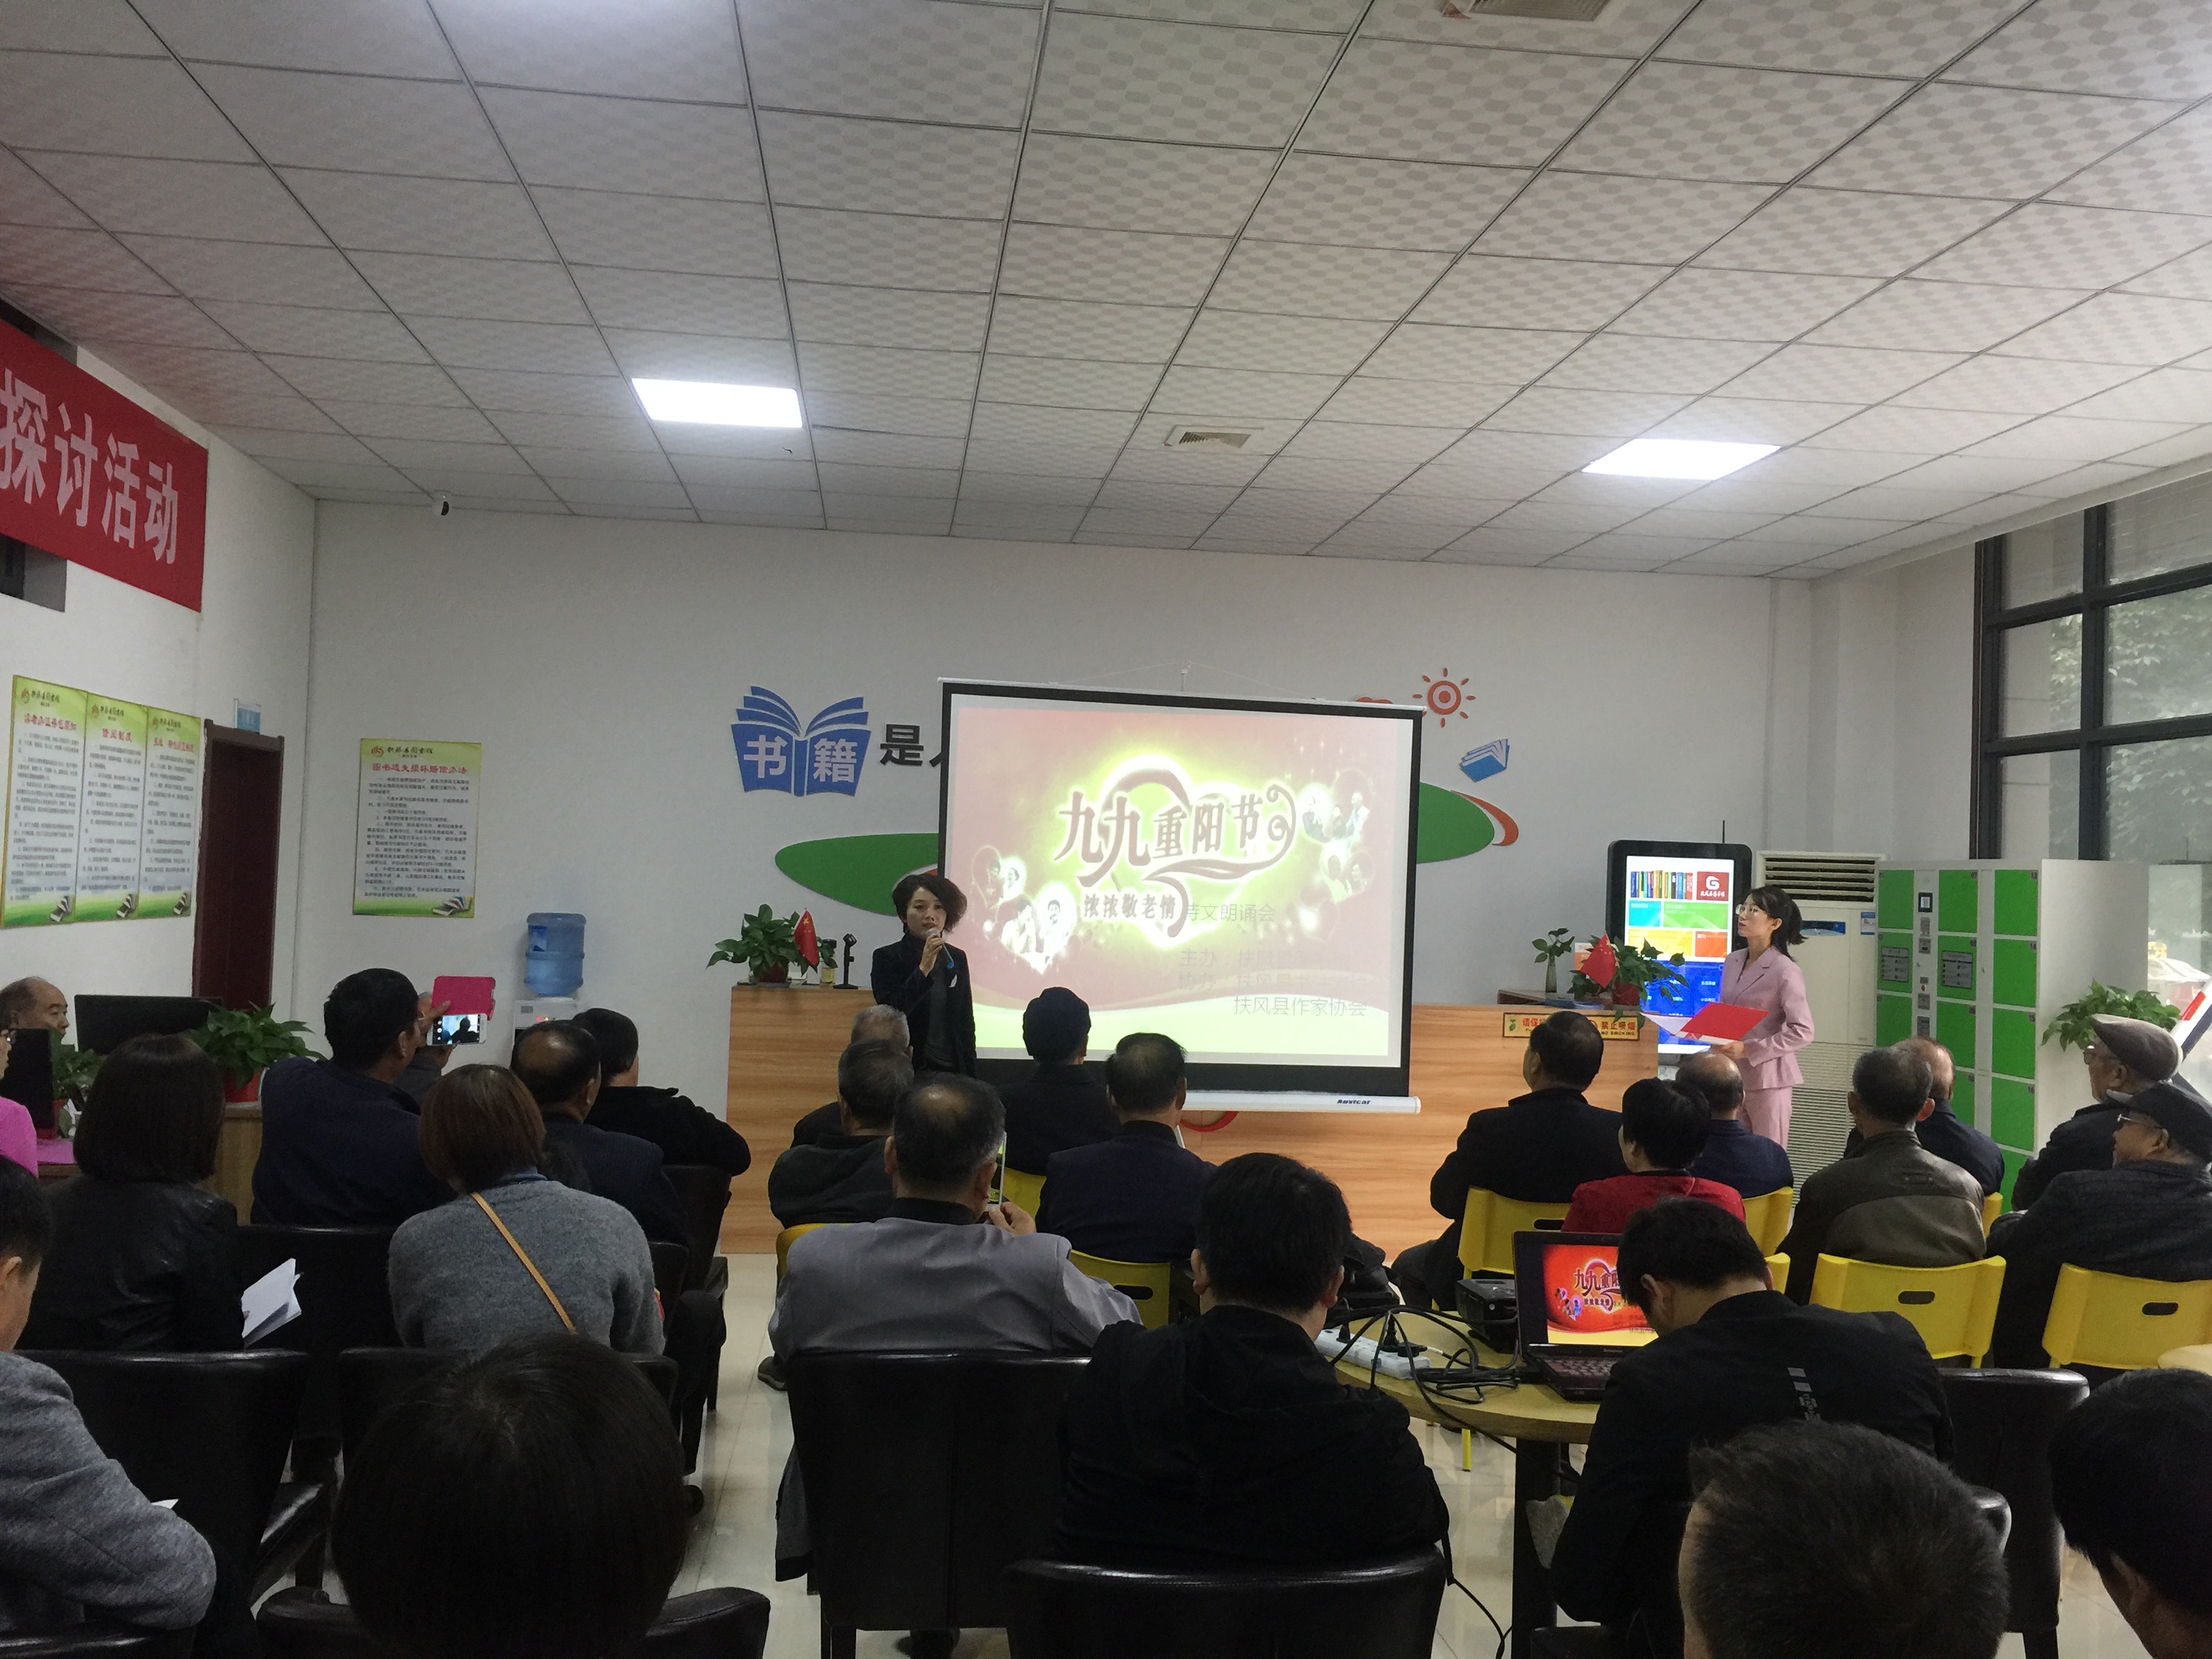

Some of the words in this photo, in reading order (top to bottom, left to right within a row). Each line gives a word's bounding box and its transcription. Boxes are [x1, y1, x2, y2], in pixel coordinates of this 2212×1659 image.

[0, 368, 178, 564] 探讨活动
[372, 762, 468, 775] 图书遗失损坏赔偿办法
[743, 735, 858, 783] 书籍
[1054, 790, 1263, 888] 九九重阳节
[1084, 893, 1176, 920] 浓浓敬老情
[1233, 996, 1367, 1017] 扶风县作家协会
[1601, 1021, 1636, 1031] 禁止吸烟
